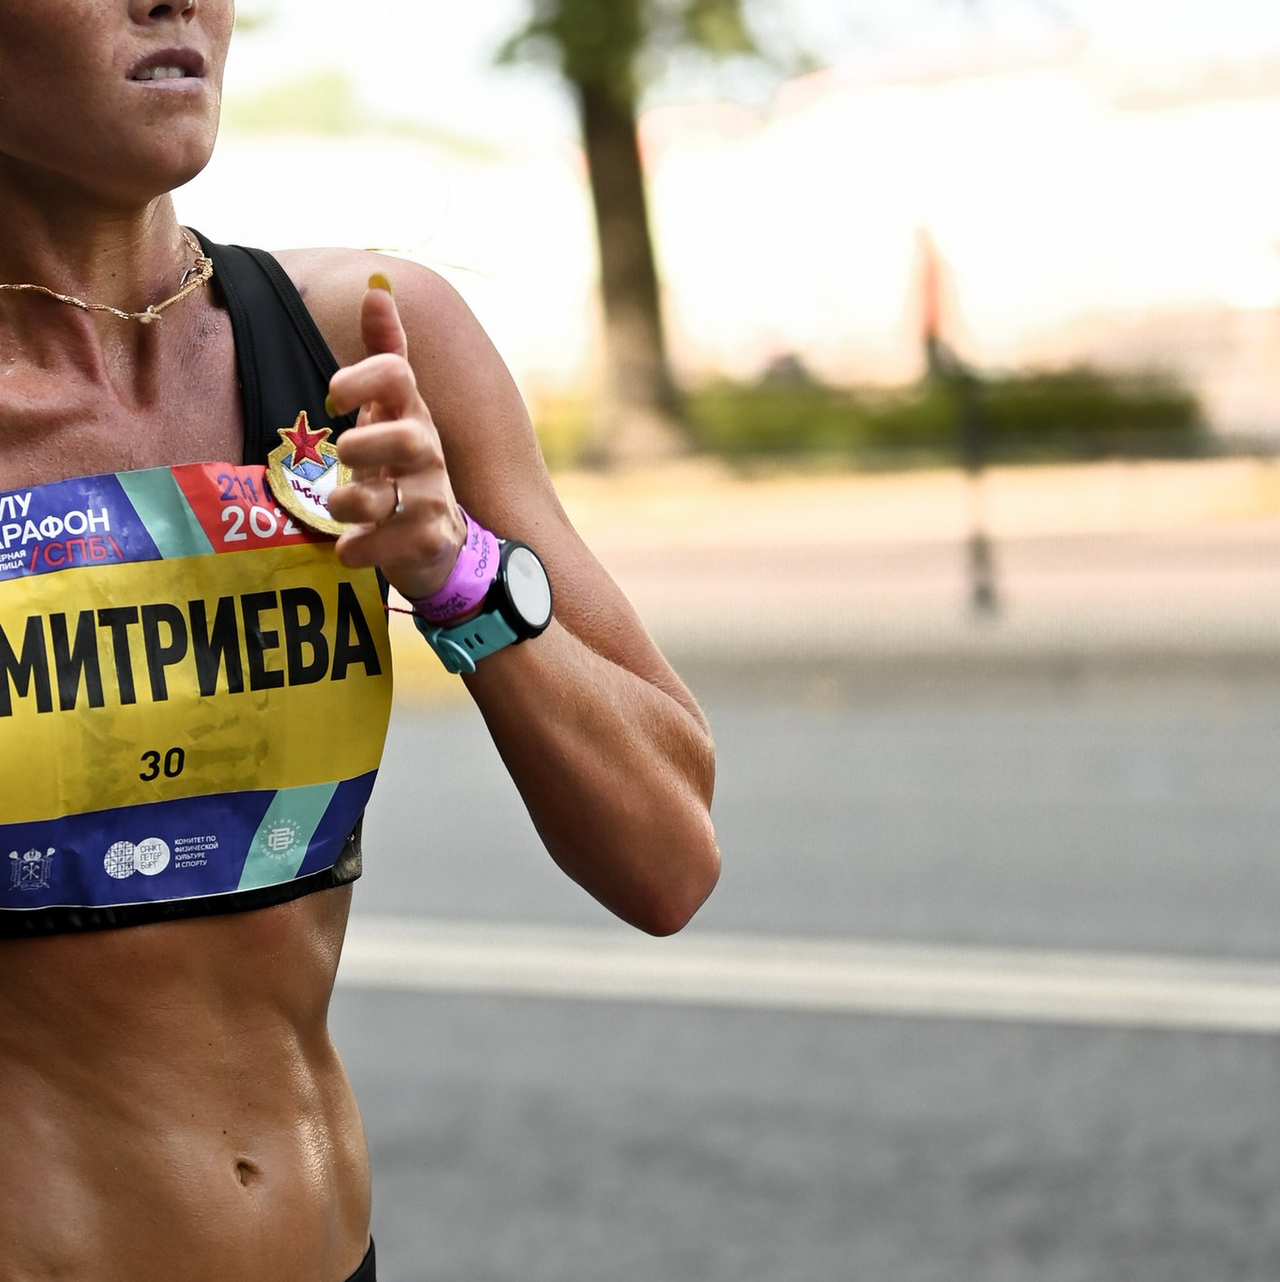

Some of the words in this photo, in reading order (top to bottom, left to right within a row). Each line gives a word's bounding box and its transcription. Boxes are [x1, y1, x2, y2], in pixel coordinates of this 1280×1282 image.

[221, 504, 304, 542] 202
[139, 747, 185, 782] 30
[174, 836, 205, 845] КОМИТЕТ
[174, 842, 219, 853] ФИЗИЧЕСКОЙ
[181, 859, 208, 869] СПОРТУ
